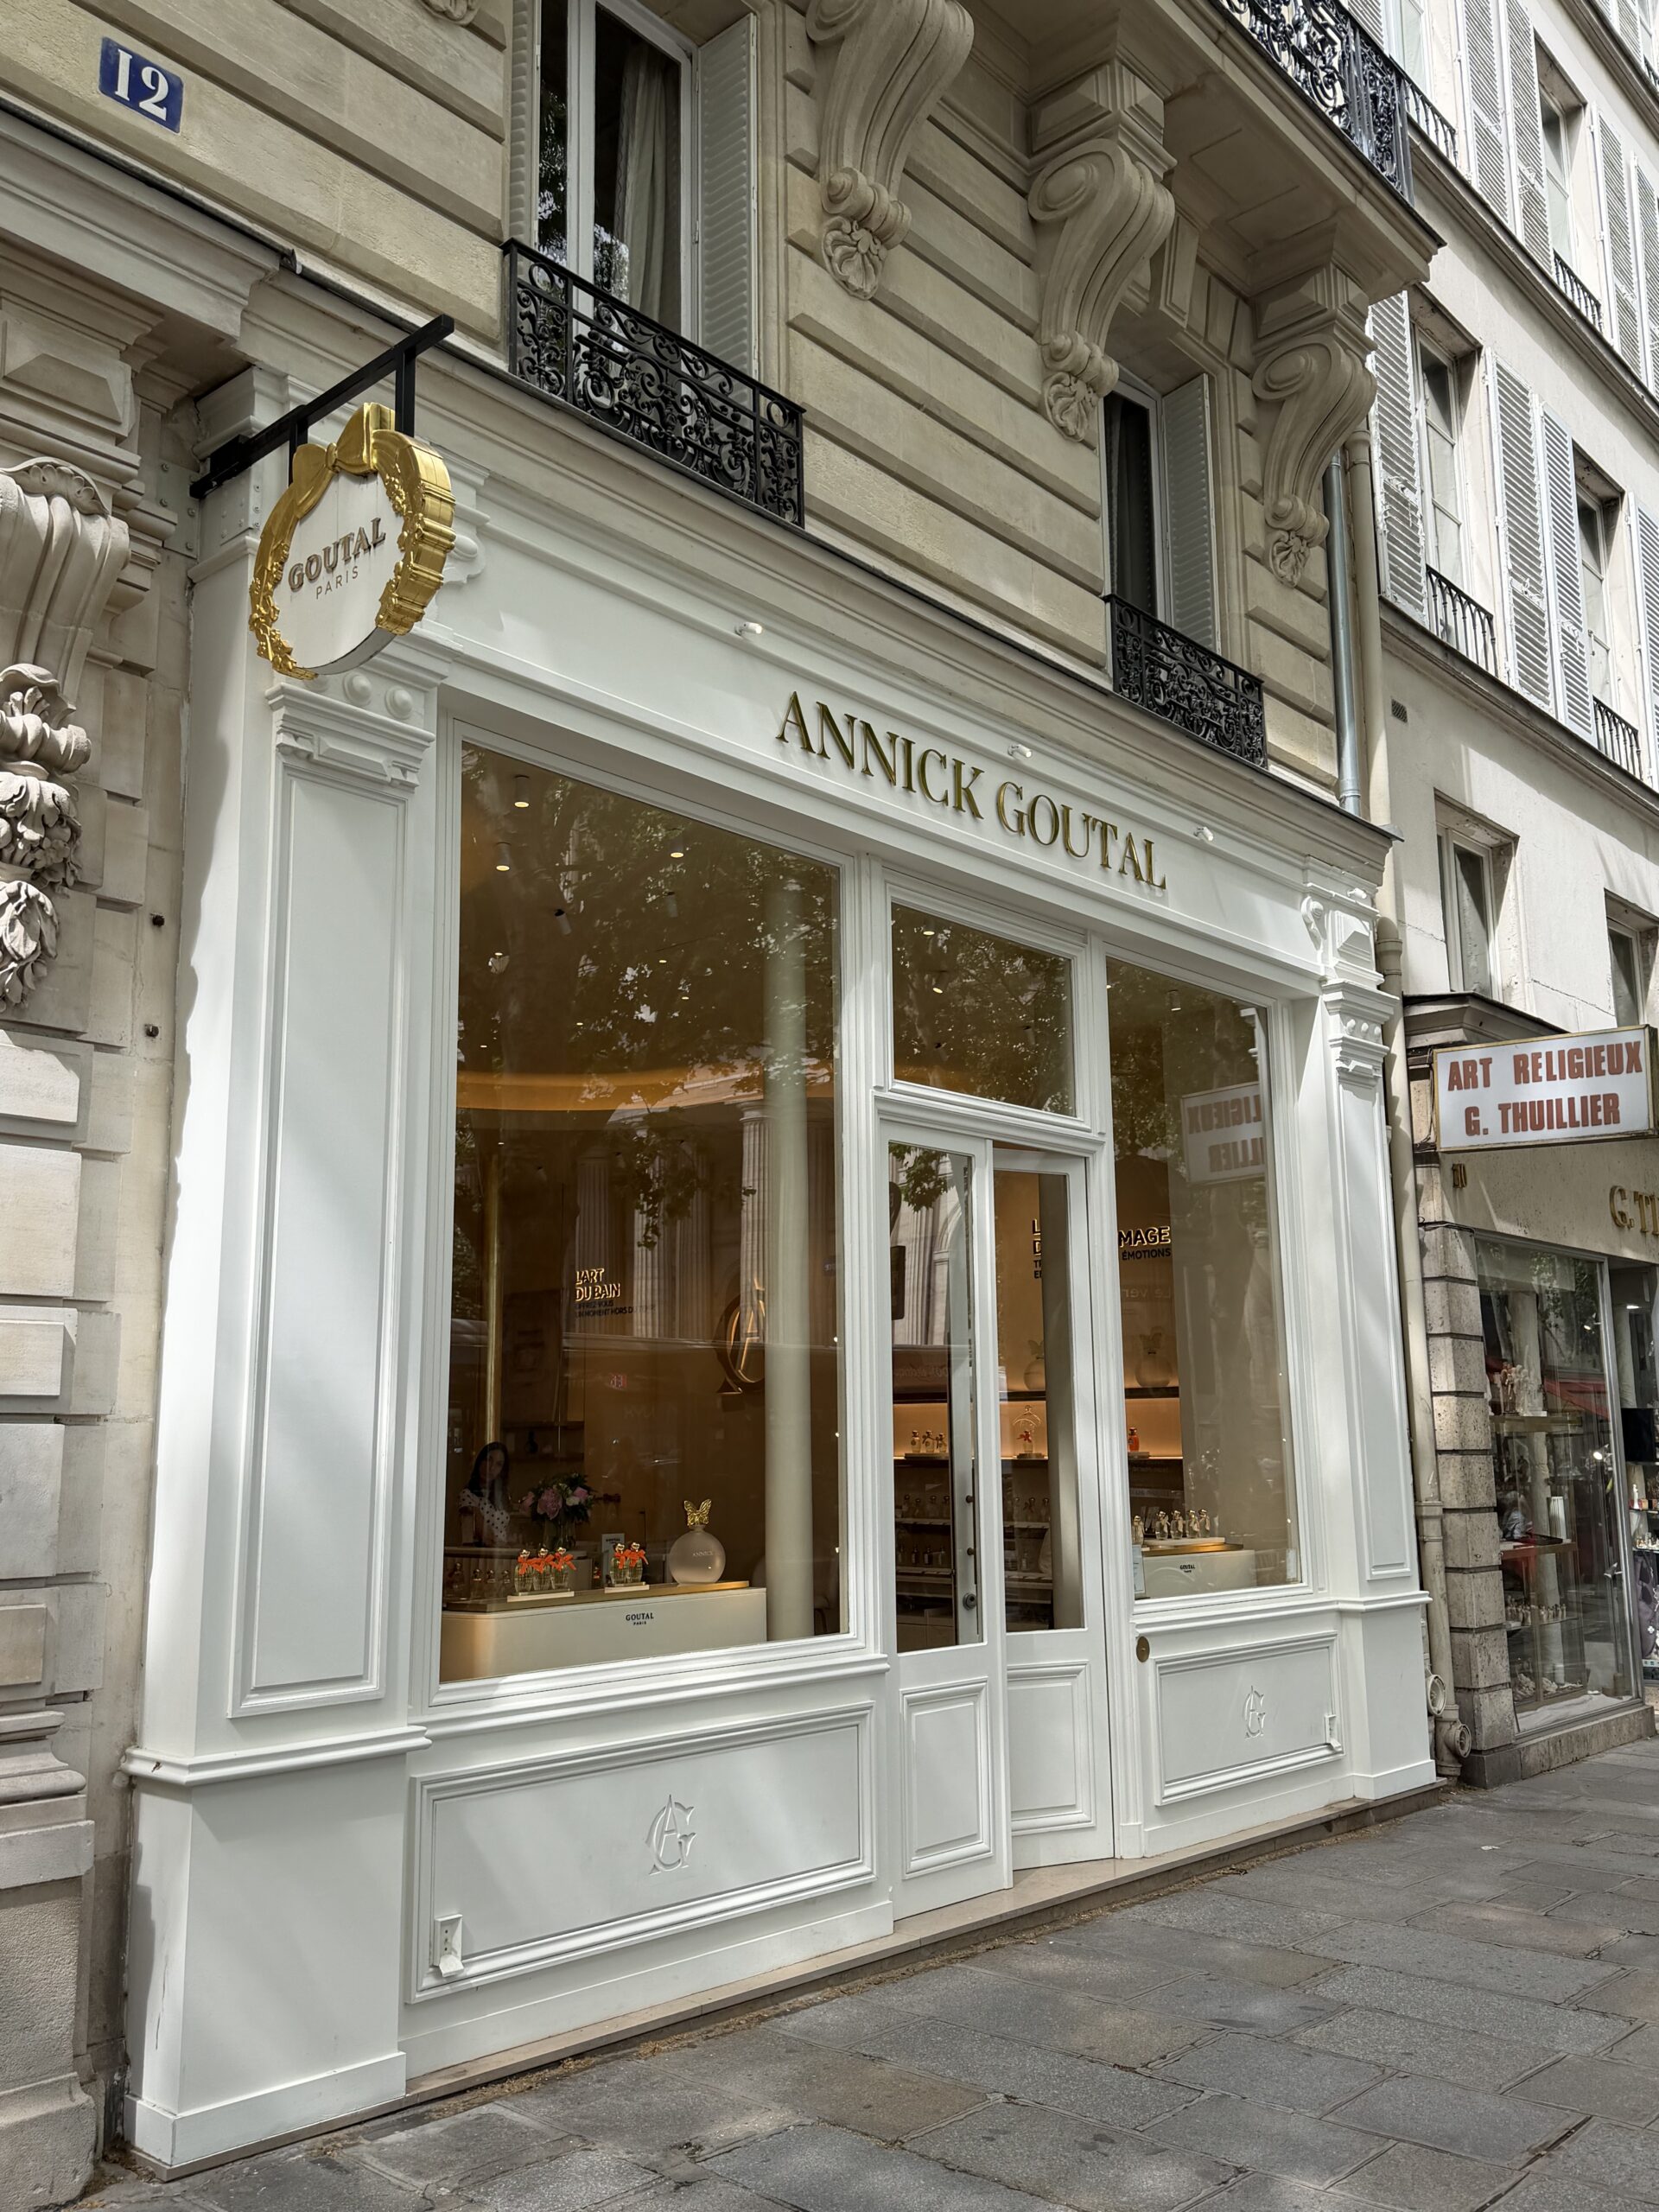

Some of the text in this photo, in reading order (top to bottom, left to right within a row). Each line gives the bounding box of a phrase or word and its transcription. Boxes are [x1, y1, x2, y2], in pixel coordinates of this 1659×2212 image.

[115, 48, 168, 121] 12
[288, 517, 386, 592] GOUTAL
[316, 566, 358, 600] PARIS
[776, 690, 1166, 890] ANNICK GOUTAL
[1448, 1041, 1643, 1091] ART RELIGIEUX
[1465, 1093, 1620, 1136] G. THUILLIER
[575, 1283, 621, 1302] DU BAIN
[625, 1611, 654, 1621] GOUTAL
